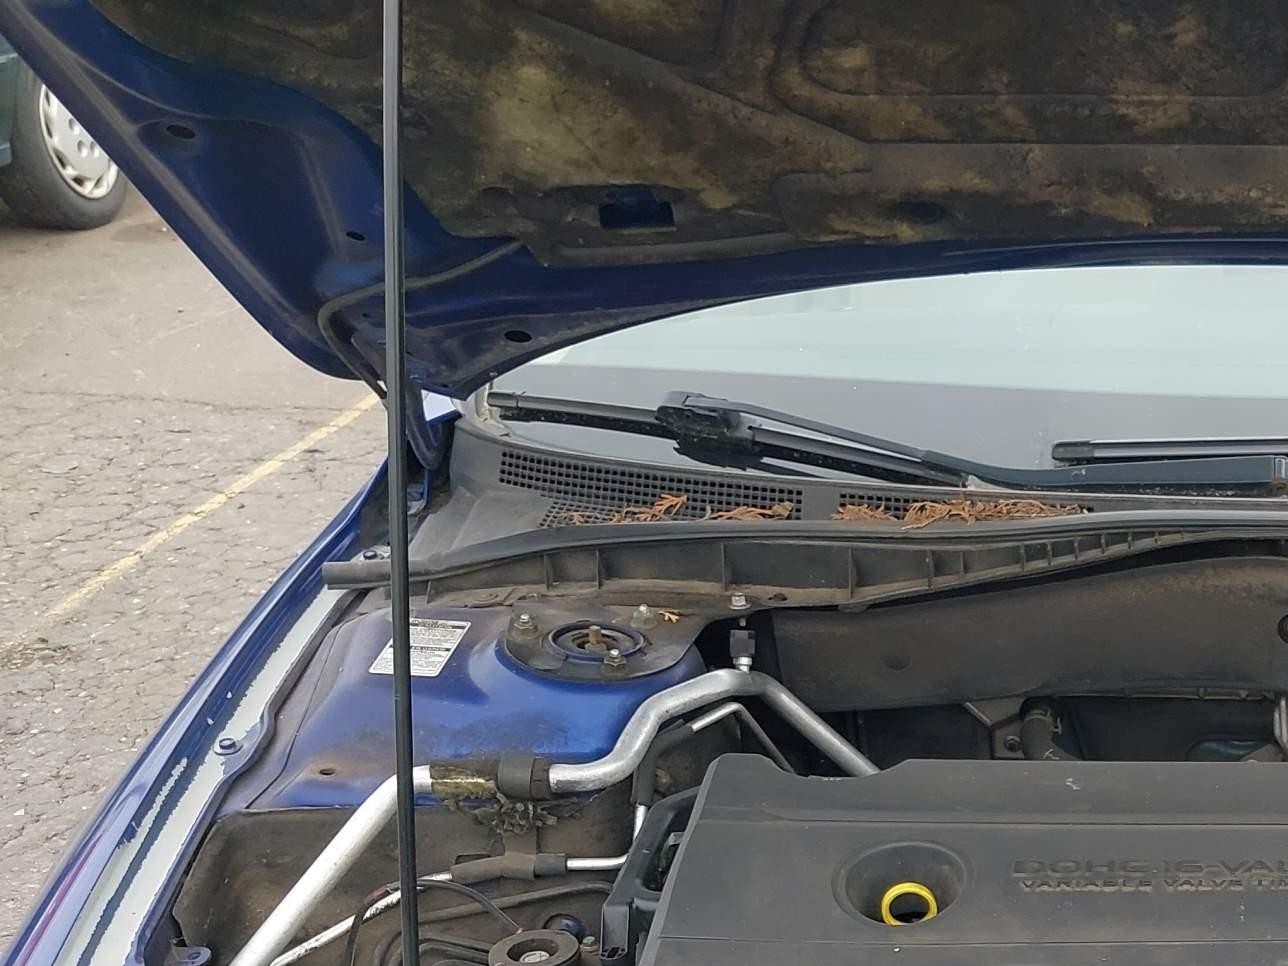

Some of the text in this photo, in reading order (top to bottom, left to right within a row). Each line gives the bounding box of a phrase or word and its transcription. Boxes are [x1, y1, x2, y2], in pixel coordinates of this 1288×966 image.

[1012, 859, 1150, 877] DOHC
[1022, 879, 1154, 891] VARIABLE
[1164, 878, 1244, 890] VALVE
